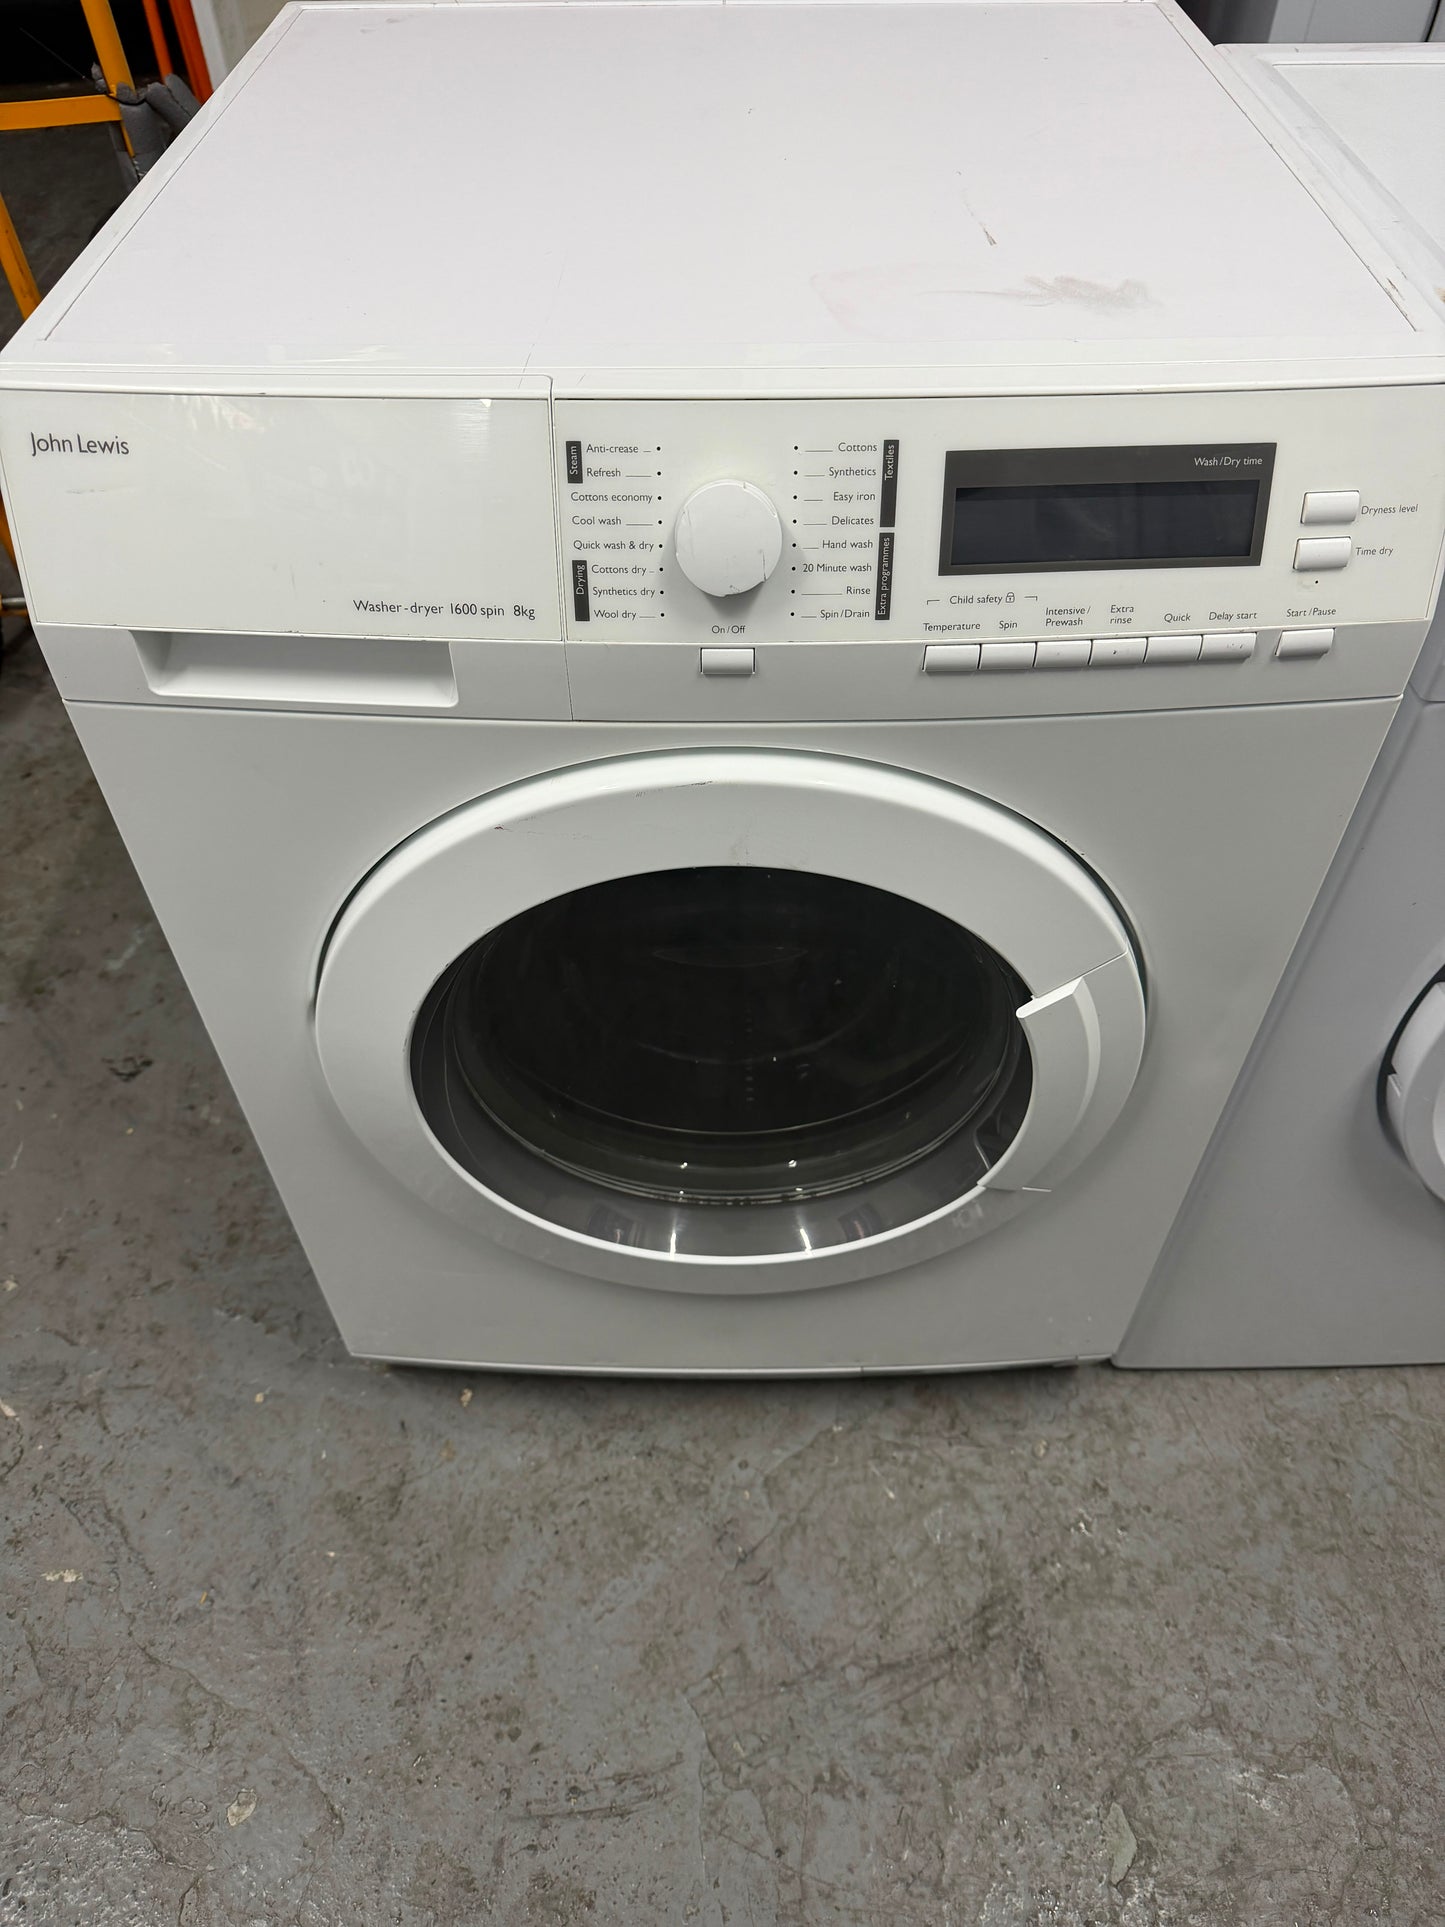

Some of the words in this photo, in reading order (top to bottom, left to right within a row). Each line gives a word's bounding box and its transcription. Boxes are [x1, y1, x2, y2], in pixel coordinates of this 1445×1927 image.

[31, 432, 73, 457] John
[77, 433, 129, 455] Lewis
[586, 444, 638, 453] Anti-crease
[838, 443, 877, 452] Cottons
[569, 446, 578, 474] Steam
[884, 444, 895, 480] Textiles
[1243, 457, 1262, 465] time
[587, 468, 621, 477] Refresh
[829, 467, 876, 478] Synthetics
[571, 492, 608, 501] Cottons
[612, 494, 652, 504] economy
[834, 492, 853, 503] Easy
[1361, 505, 1396, 516] Dryness
[1399, 504, 1418, 513] level
[572, 516, 595, 525] Cool
[598, 517, 621, 525] wash
[832, 516, 874, 525] Delicates
[574, 540, 600, 550] Quick
[604, 541, 626, 549] wash
[639, 541, 654, 552] dry
[823, 540, 846, 549] Hand
[850, 540, 873, 549] wash
[1356, 547, 1376, 556] Time
[1379, 547, 1393, 556] dry
[803, 564, 814, 572] 20
[817, 564, 847, 572] Minute
[850, 563, 871, 572] wash
[880, 538, 891, 590] programmes
[592, 565, 628, 574] Cottons
[632, 566, 646, 576] dry
[575, 565, 586, 594] Drying
[593, 587, 637, 598] Synthetics
[640, 587, 655, 598] dry
[846, 586, 870, 595] Rinse
[877, 593, 887, 615] Extra
[950, 595, 974, 605] Child
[976, 594, 1002, 606] safety
[450, 603, 477, 616] 1600
[480, 604, 505, 619] spin
[514, 605, 535, 621] 8kg
[594, 610, 618, 618] Wool
[622, 610, 636, 620] dry
[1110, 605, 1134, 615] Extra
[1046, 617, 1084, 627] Prewash
[1110, 617, 1132, 625] rinse
[1164, 612, 1191, 623] Quick
[1209, 611, 1233, 623] Delay
[1235, 611, 1257, 620] start
[923, 622, 980, 633] Temperature
[999, 620, 1017, 631] Spin
